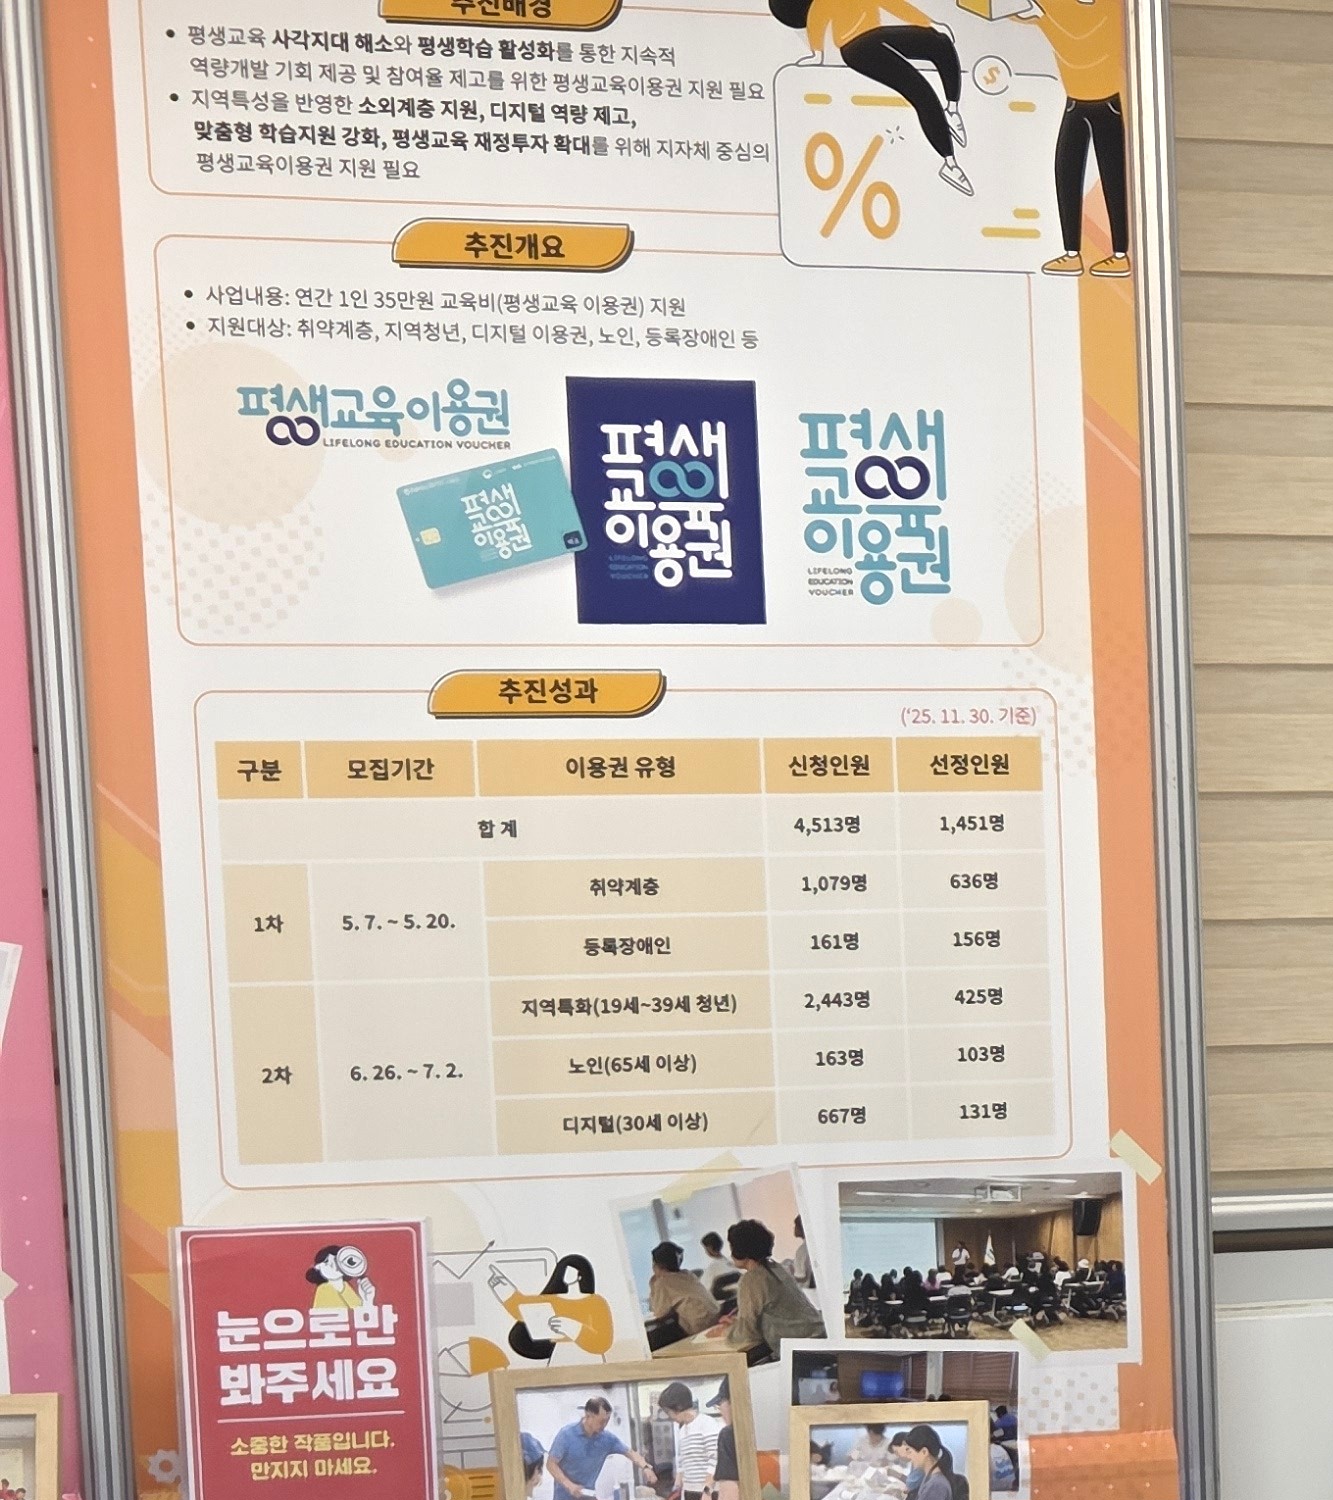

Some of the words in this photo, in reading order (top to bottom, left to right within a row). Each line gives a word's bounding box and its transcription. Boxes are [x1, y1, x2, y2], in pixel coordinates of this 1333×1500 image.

[187, 24, 267, 49] 평생교육
[271, 28, 350, 53] 사각지대
[354, 32, 413, 56] 해소와
[417, 35, 494, 60] 평생학습
[497, 38, 574, 63] 활성화를
[578, 42, 617, 65] 통한
[620, 44, 676, 68] 지속적
[189, 56, 270, 81] 역량개발
[275, 60, 313, 83] 기회
[318, 62, 357, 85] 제공
[362, 64, 381, 86] 및
[386, 65, 444, 88] 참여율
[448, 68, 505, 91] 제고를
[510, 70, 548, 92] 위한
[552, 72, 683, 98] 평생교육이용권
[687, 78, 723, 100] 지원
[728, 78, 766, 102] 필요
[464, 231, 566, 261] 추진개요
[205, 284, 291, 307] 사업내용:
[294, 287, 334, 309] 연간
[339, 289, 369, 310] 1인
[373, 290, 435, 311] 35만원
[440, 291, 579, 315] 교육비(평생교육
[583, 294, 645, 319] 이용권)
[649, 296, 686, 318] 지원
[207, 316, 292, 339] 지원대상:
[297, 318, 380, 343] 취약계층,
[384, 320, 467, 345] 지역청년,
[471, 322, 527, 344] 디지털
[532, 324, 594, 348] 이용권,
[598, 326, 641, 349] 노인,
[644, 327, 736, 349] 등록장애인
[740, 330, 759, 350] 등
[322, 437, 382, 448] LIFELONG
[384, 438, 453, 450] EDUCATION
[455, 440, 511, 451] VOUCHER
[807, 566, 853, 576] LIFELONG
[807, 577, 854, 586] EDUCATION
[808, 588, 854, 597] VOUCHER
[498, 677, 599, 705] 추진성과
[236, 759, 283, 783] 구분
[347, 757, 435, 782] 모집기간
[565, 756, 629, 780] 이용권
[634, 755, 676, 779] 유형
[788, 754, 871, 777] 신청인원
[929, 752, 1010, 776] 선정인원
[793, 814, 861, 837] 4,513명
[940, 813, 1005, 835] 1,451명
[589, 877, 660, 897] 취약계층
[801, 873, 868, 896] 1,079명
[949, 871, 999, 890] 636명
[254, 914, 285, 934] 1차
[583, 936, 672, 957] 등록장애인
[810, 931, 860, 951] 161명
[953, 929, 1001, 948] 156명
[521, 994, 691, 1018] 지역특화(19세~39세
[695, 993, 737, 1015] 청년)
[803, 989, 871, 1012] 2,443명
[954, 986, 1003, 1006] 425명
[568, 1054, 651, 1077] 노인(65세
[655, 1053, 697, 1075] 이상)
[815, 1048, 864, 1067] 163명
[957, 1044, 1005, 1063] 103명
[261, 1065, 293, 1086] 2차
[817, 1105, 867, 1125] 667명
[959, 1101, 1008, 1120] 131명
[562, 1113, 662, 1136] 디지털(30세
[667, 1111, 709, 1133] 이상)
[216, 1305, 399, 1353] 눈으로만
[219, 1357, 400, 1406] 봐주세요
[230, 1434, 289, 1456] 소중한
[293, 1429, 395, 1453] 작품입니다.
[250, 1459, 309, 1481] 만지지
[314, 1456, 378, 1477] 마세요.
